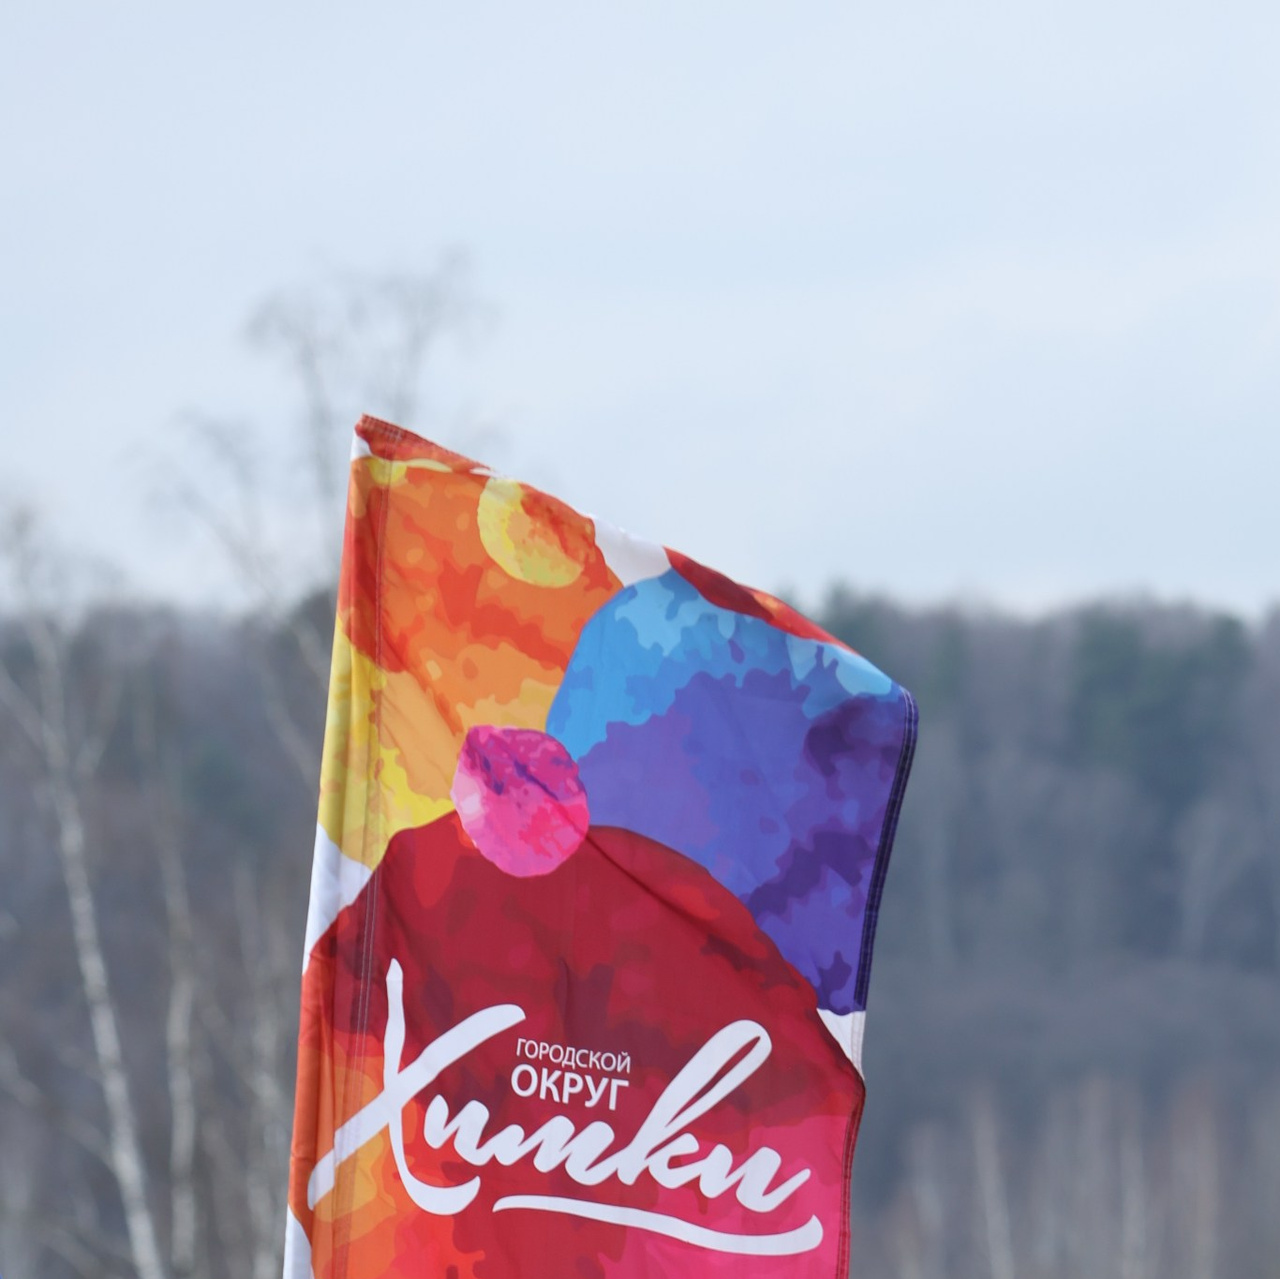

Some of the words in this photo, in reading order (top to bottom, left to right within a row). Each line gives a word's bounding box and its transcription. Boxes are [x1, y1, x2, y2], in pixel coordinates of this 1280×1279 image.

[516, 1037, 631, 1074] ГОРОДСКОЙ
[307, 958, 811, 1216] Химки
[511, 1063, 630, 1111] ОКРУГ
